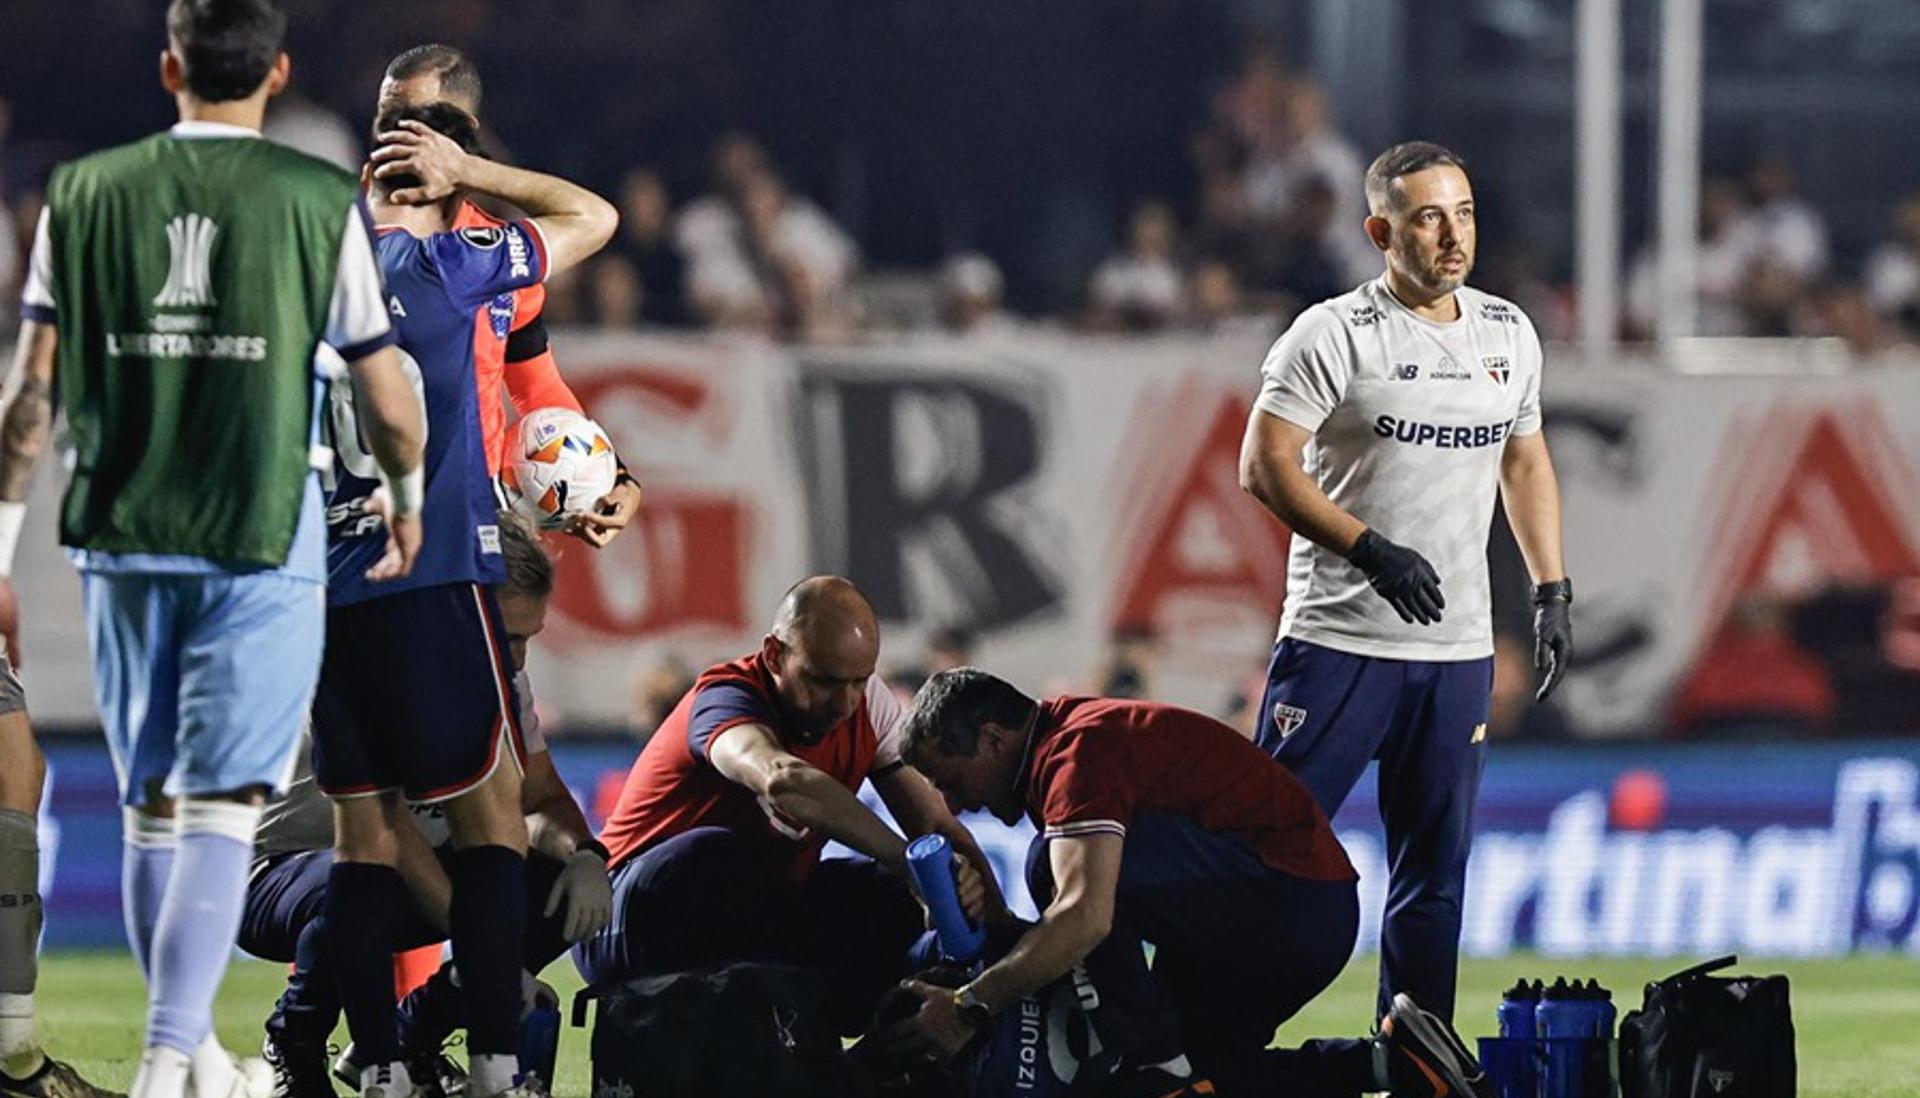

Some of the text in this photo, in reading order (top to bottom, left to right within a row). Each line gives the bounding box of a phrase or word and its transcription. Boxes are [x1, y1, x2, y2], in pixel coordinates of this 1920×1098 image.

[106, 332, 268, 361] LIBERTADORES
[1374, 414, 1514, 449] SUPERBET
[1016, 995, 1041, 1090] IZQUIE
